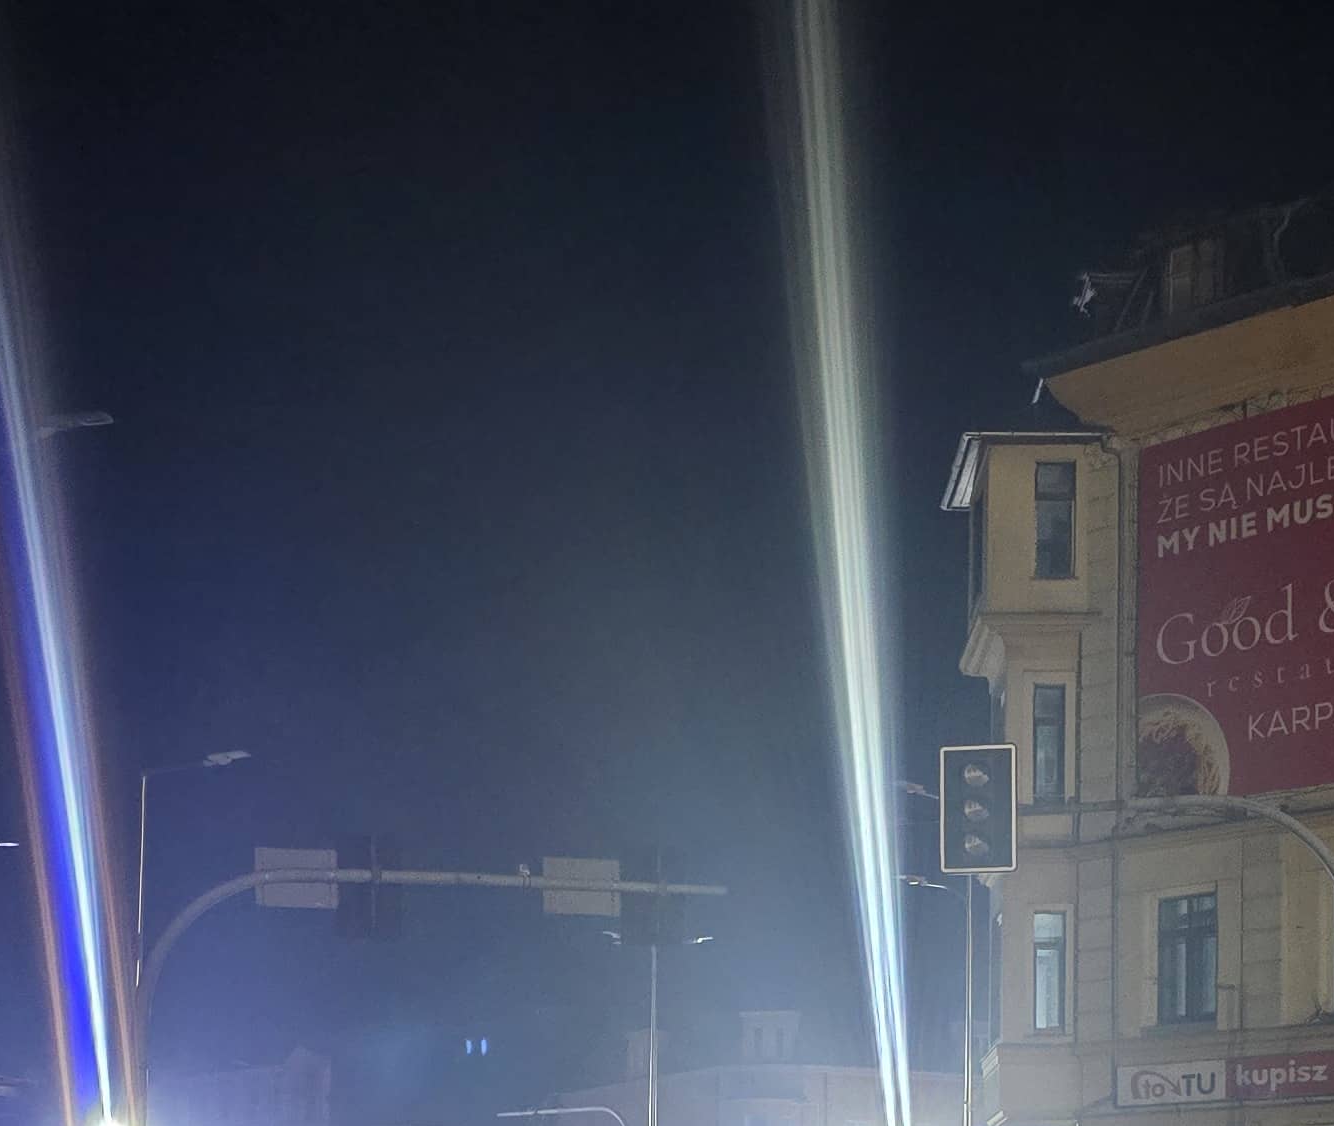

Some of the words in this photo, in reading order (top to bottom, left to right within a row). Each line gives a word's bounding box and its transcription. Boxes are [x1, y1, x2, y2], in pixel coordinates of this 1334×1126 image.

[1157, 448, 1224, 488] INNE
[1157, 494, 1189, 525] ŻE
[1199, 482, 1240, 512] SĄ
[1157, 525, 1200, 558] MY
[1208, 512, 1258, 547] NIE
[1156, 584, 1299, 665] Good
[1235, 1059, 1329, 1092] kupisz
